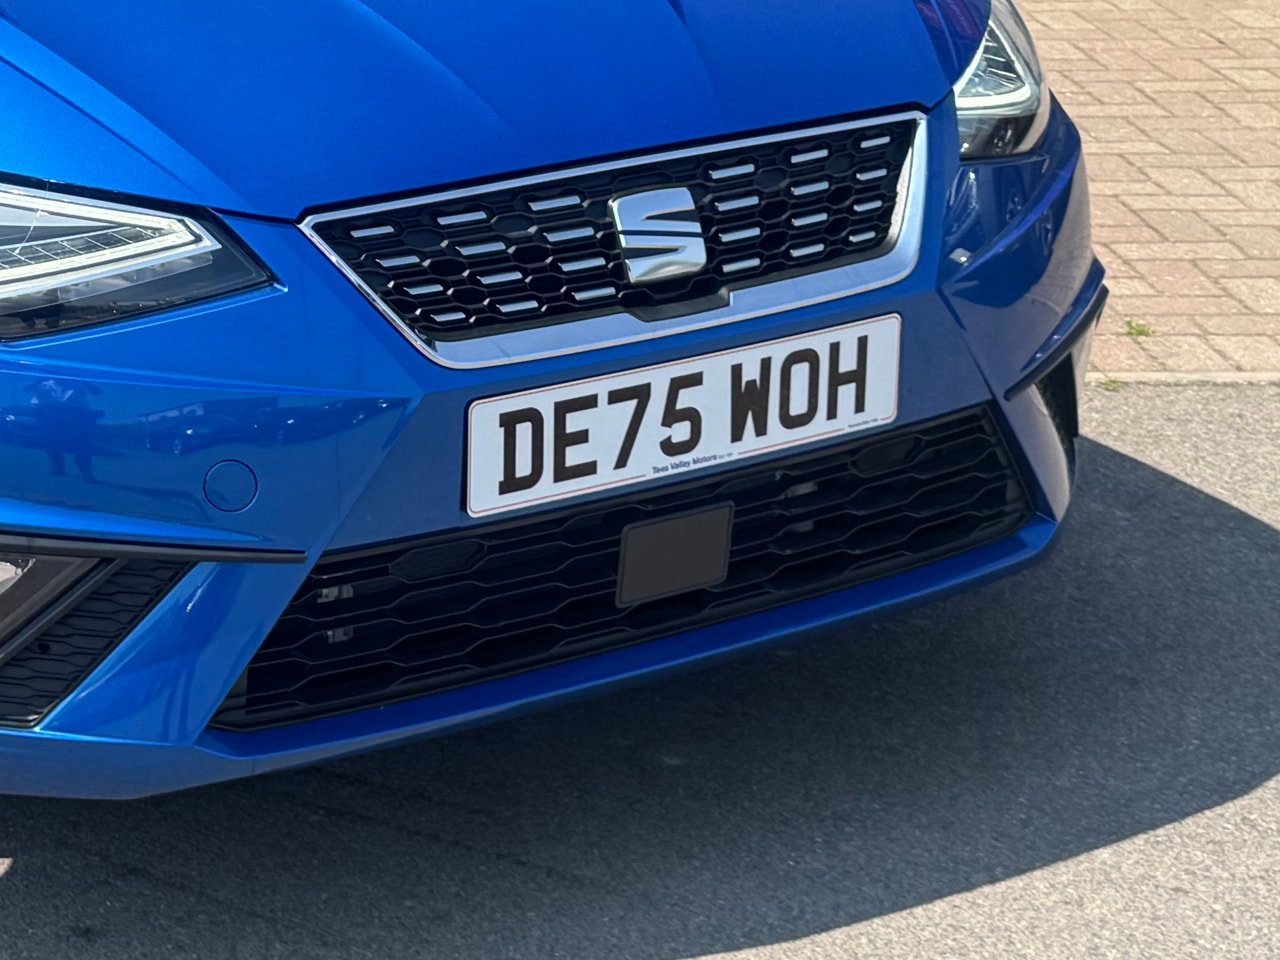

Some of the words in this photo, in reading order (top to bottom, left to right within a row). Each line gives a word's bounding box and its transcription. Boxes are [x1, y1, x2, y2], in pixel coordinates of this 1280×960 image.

[498, 371, 704, 496] DE75
[730, 334, 869, 445] WOH
[669, 459, 691, 470] Valley
[692, 454, 717, 465] Motors
